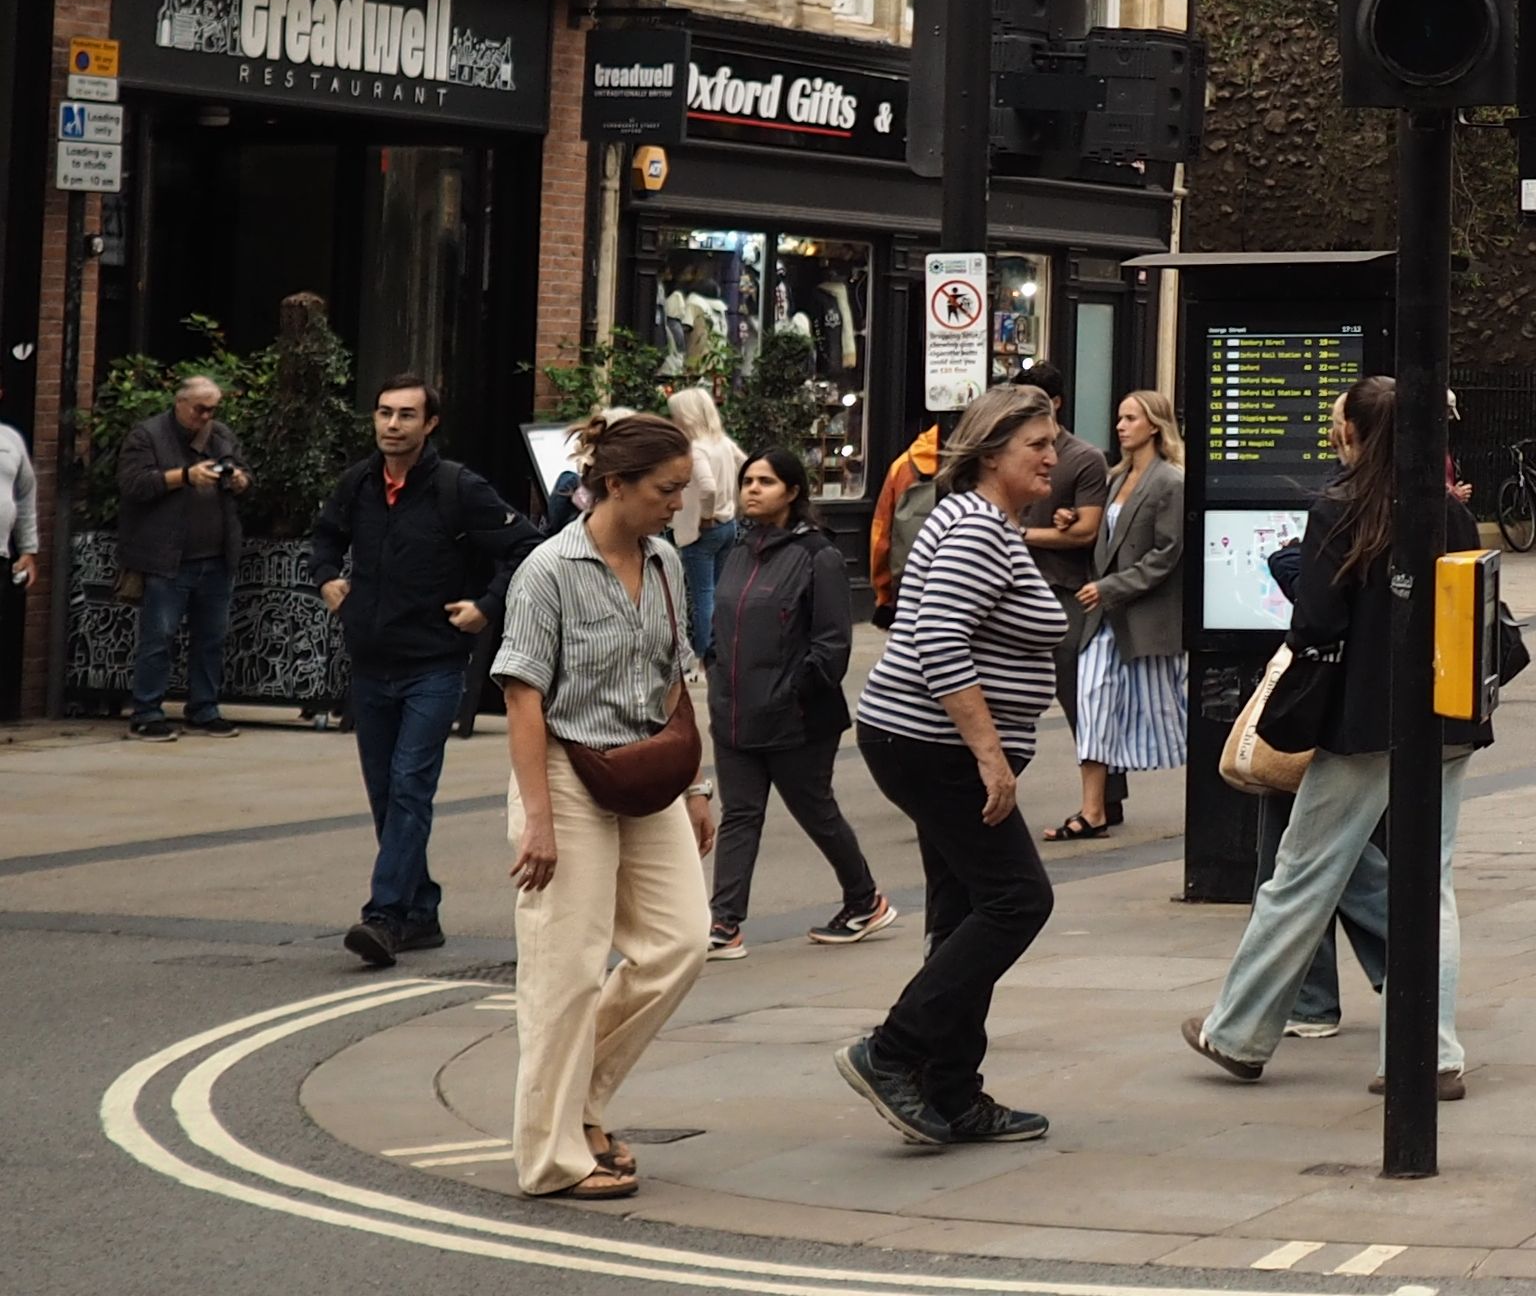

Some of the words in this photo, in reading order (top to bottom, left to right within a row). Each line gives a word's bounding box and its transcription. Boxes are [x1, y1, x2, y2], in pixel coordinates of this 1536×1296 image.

[238, 64, 449, 107] RESTAURANT
[595, 63, 674, 87] treadwell
[787, 77, 857, 129] Gifts
[874, 102, 893, 134] &
[87, 112, 120, 126] Loading
[66, 146, 99, 159] Loading
